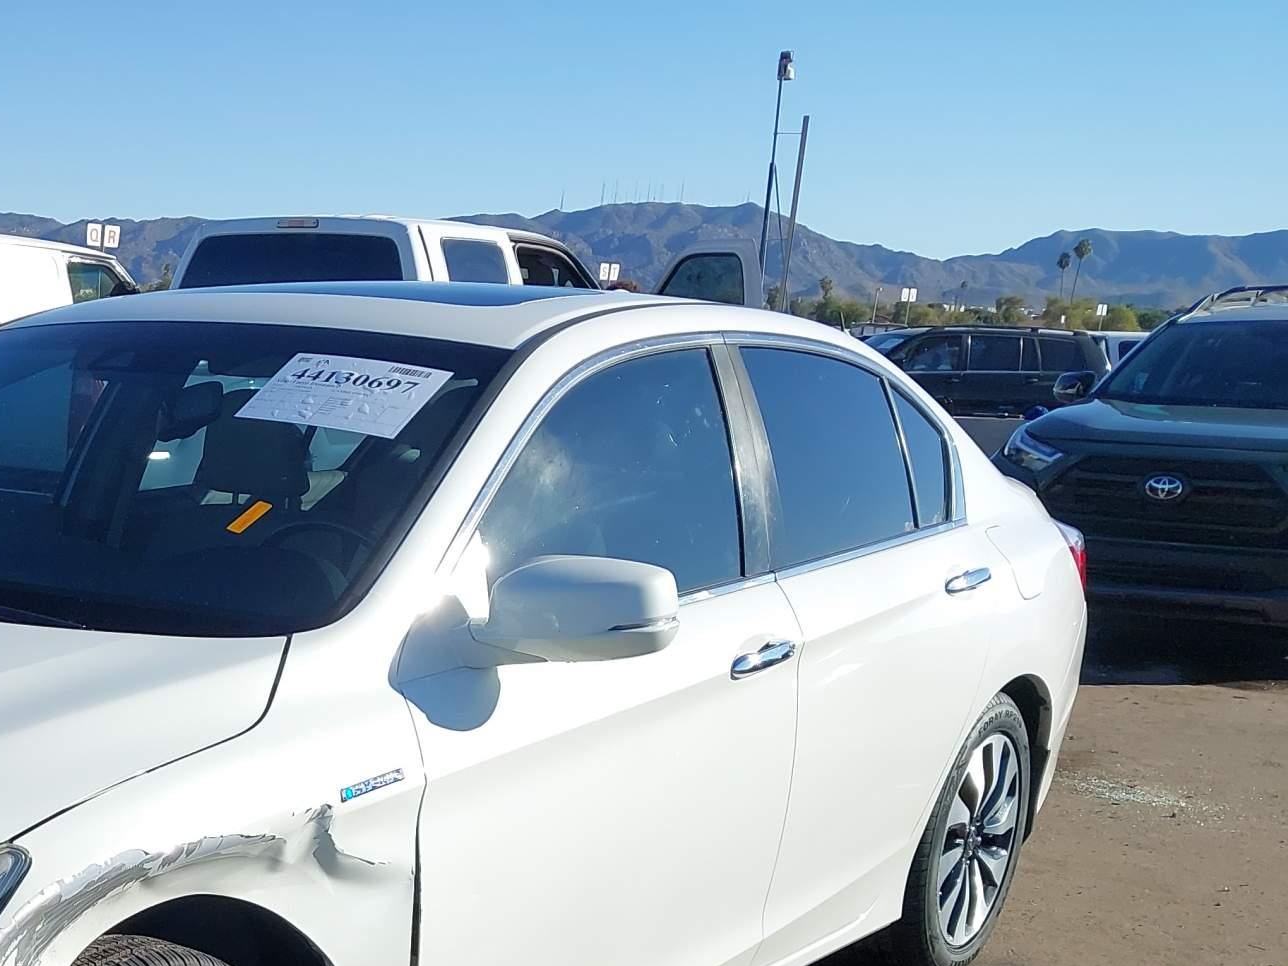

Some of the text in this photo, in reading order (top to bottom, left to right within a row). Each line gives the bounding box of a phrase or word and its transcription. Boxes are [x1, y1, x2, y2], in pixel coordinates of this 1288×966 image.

[90, 228, 99, 243] Q
[108, 230, 117, 244] R
[291, 368, 420, 393] 44130697
